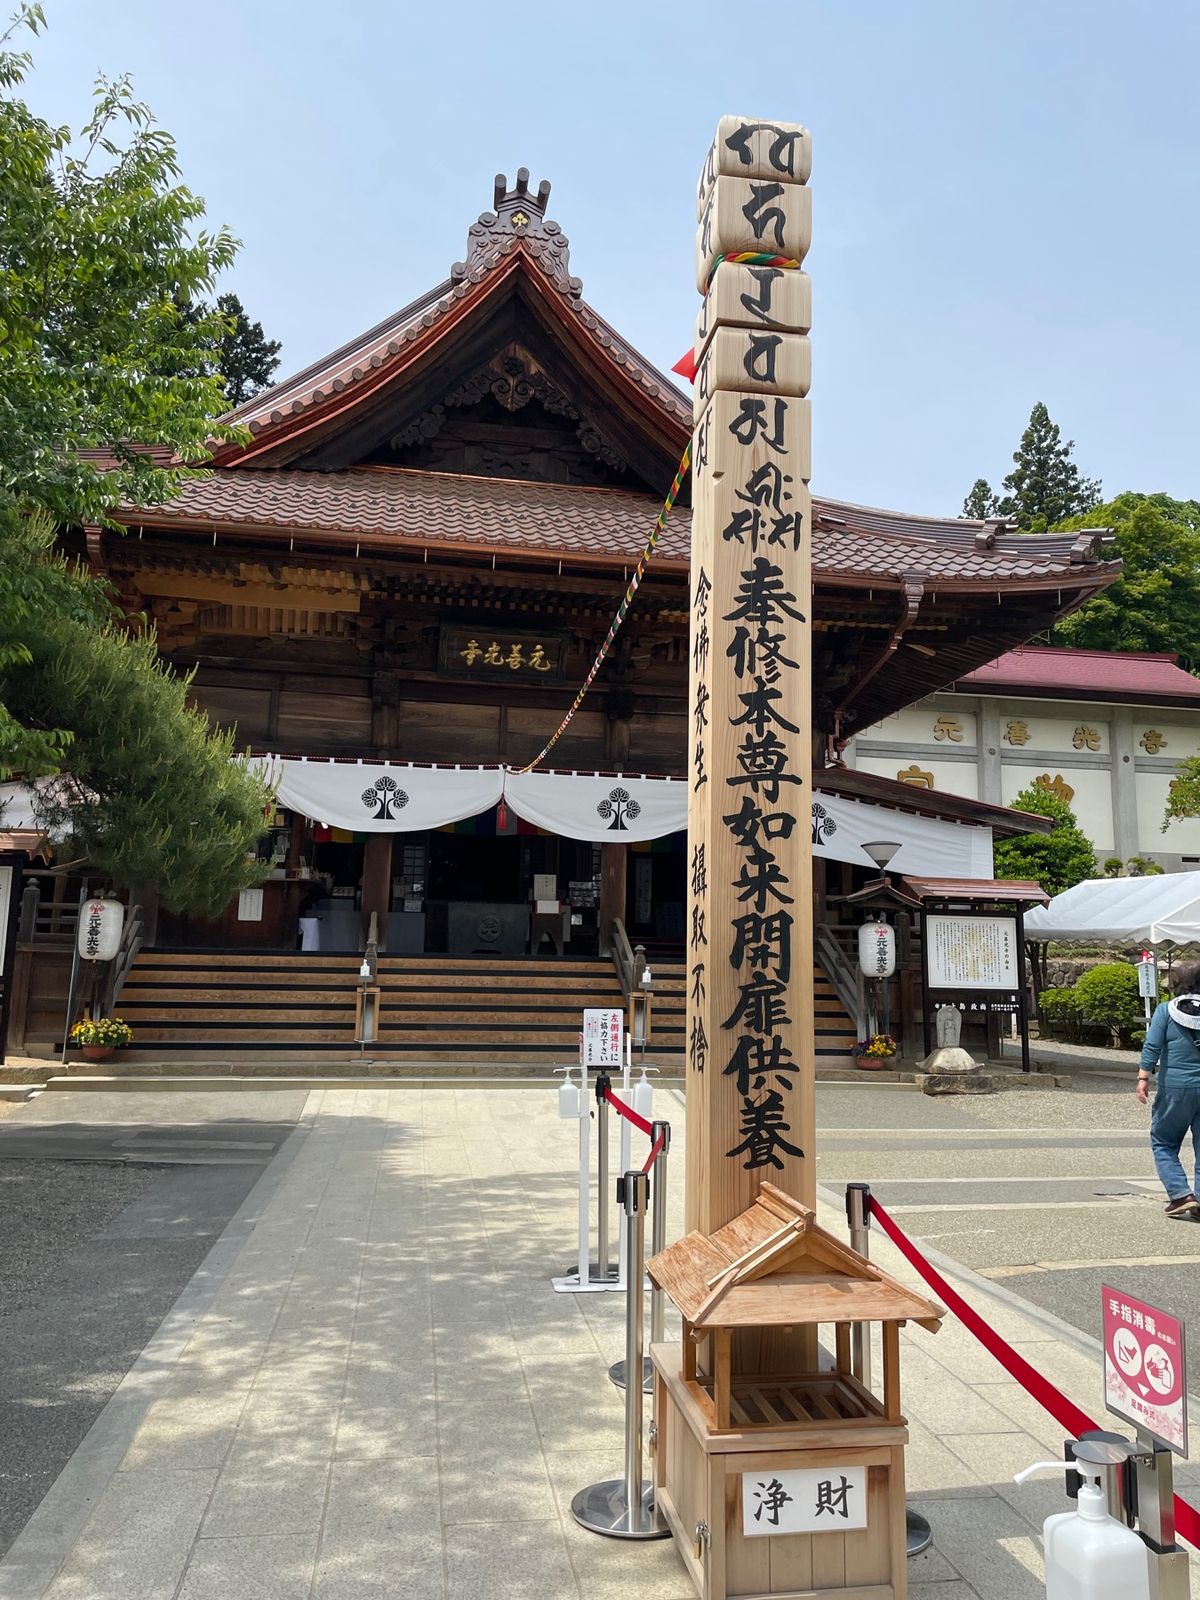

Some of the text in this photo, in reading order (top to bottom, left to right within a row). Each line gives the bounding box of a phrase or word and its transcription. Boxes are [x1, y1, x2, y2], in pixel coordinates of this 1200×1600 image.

[933, 715, 1168, 755] 元善光寺
[722, 557, 806, 1170] 奉修本尊如来開扉供養
[86, 914, 102, 956] 元善光寺
[876, 937, 889, 974] 元善光寺
[600, 1013, 608, 1062] ご協力下さい
[610, 1013, 619, 1062] 左側通行に
[753, 1475, 854, 1526] 浄財
